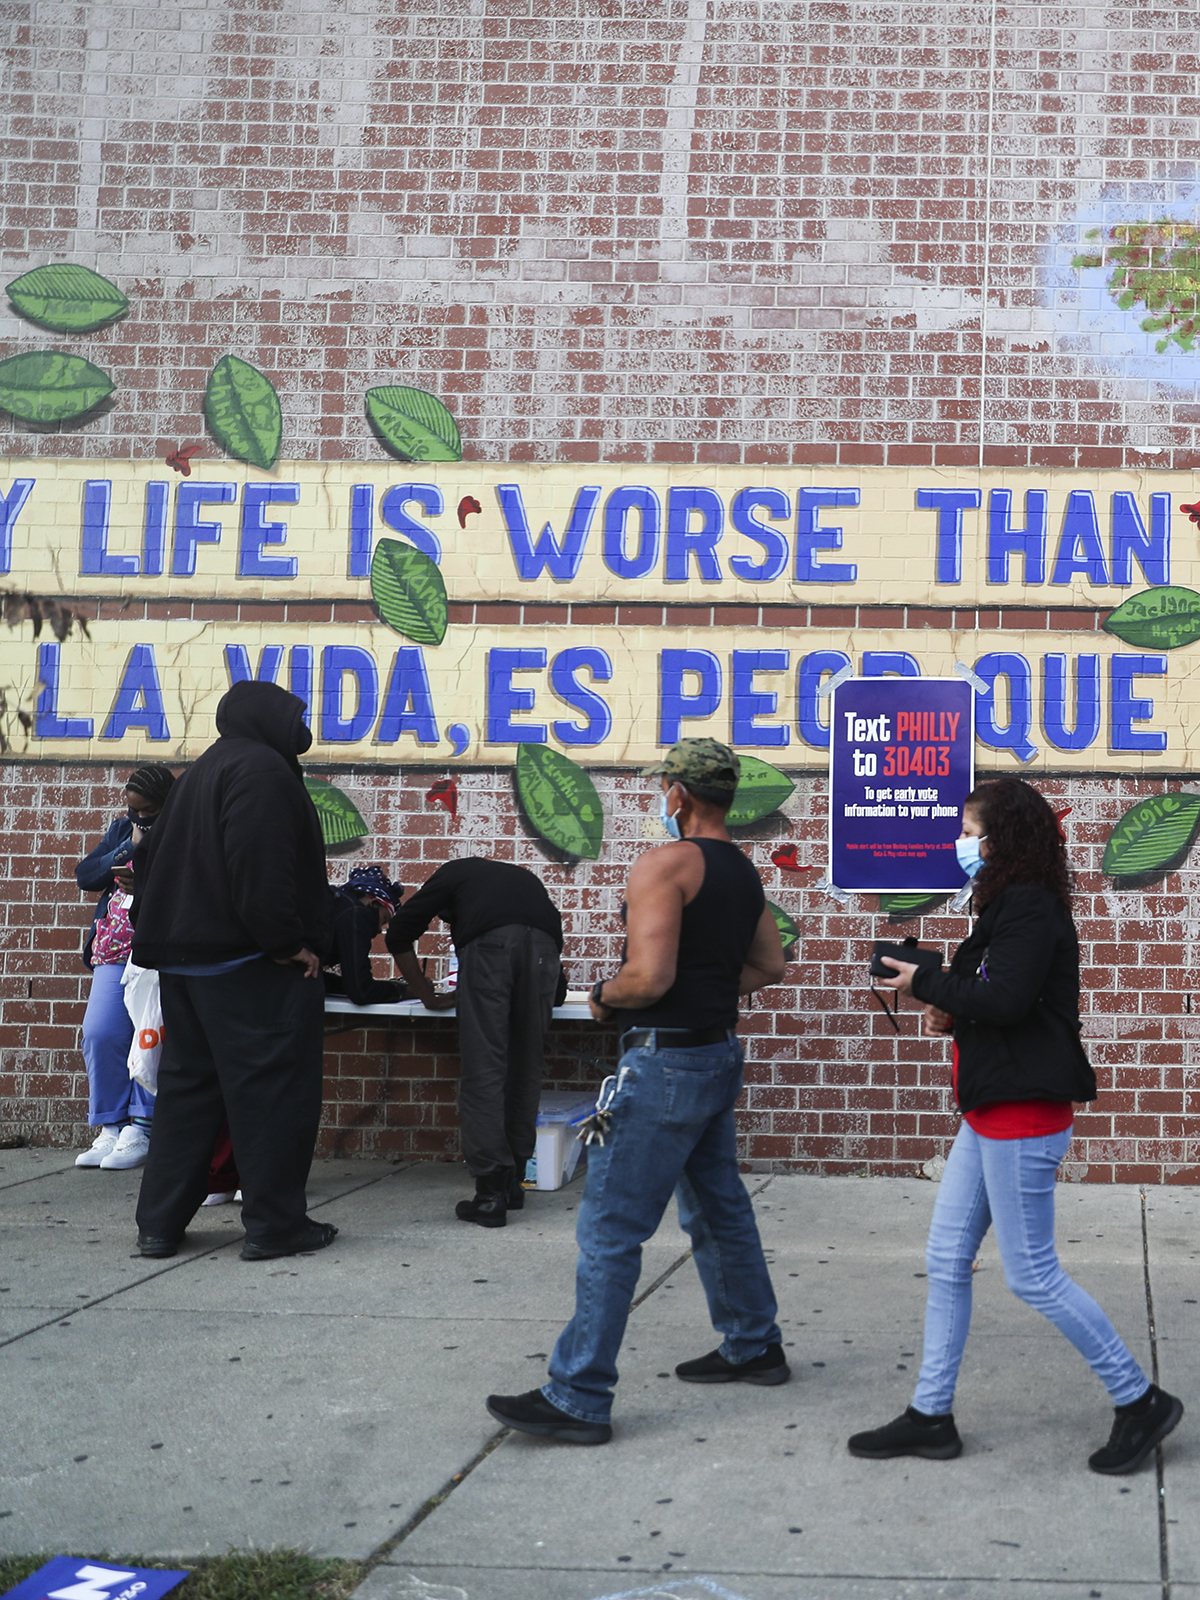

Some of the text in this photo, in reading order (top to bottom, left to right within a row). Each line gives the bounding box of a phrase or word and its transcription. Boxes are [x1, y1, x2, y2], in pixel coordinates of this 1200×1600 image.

[82, 479, 300, 577] LIFE
[349, 482, 445, 577] IS
[497, 484, 861, 583] WORSE
[916, 488, 1172, 586] THAN
[35, 642, 171, 740] LA
[488, 646, 613, 745] ES
[660, 648, 921, 747] PEO
[974, 652, 1168, 763] QUE
[844, 712, 961, 742] Text PHILLY
[853, 746, 950, 776] to 30403
[864, 786, 938, 802] To get early vote
[844, 804, 958, 819] information to your phone
